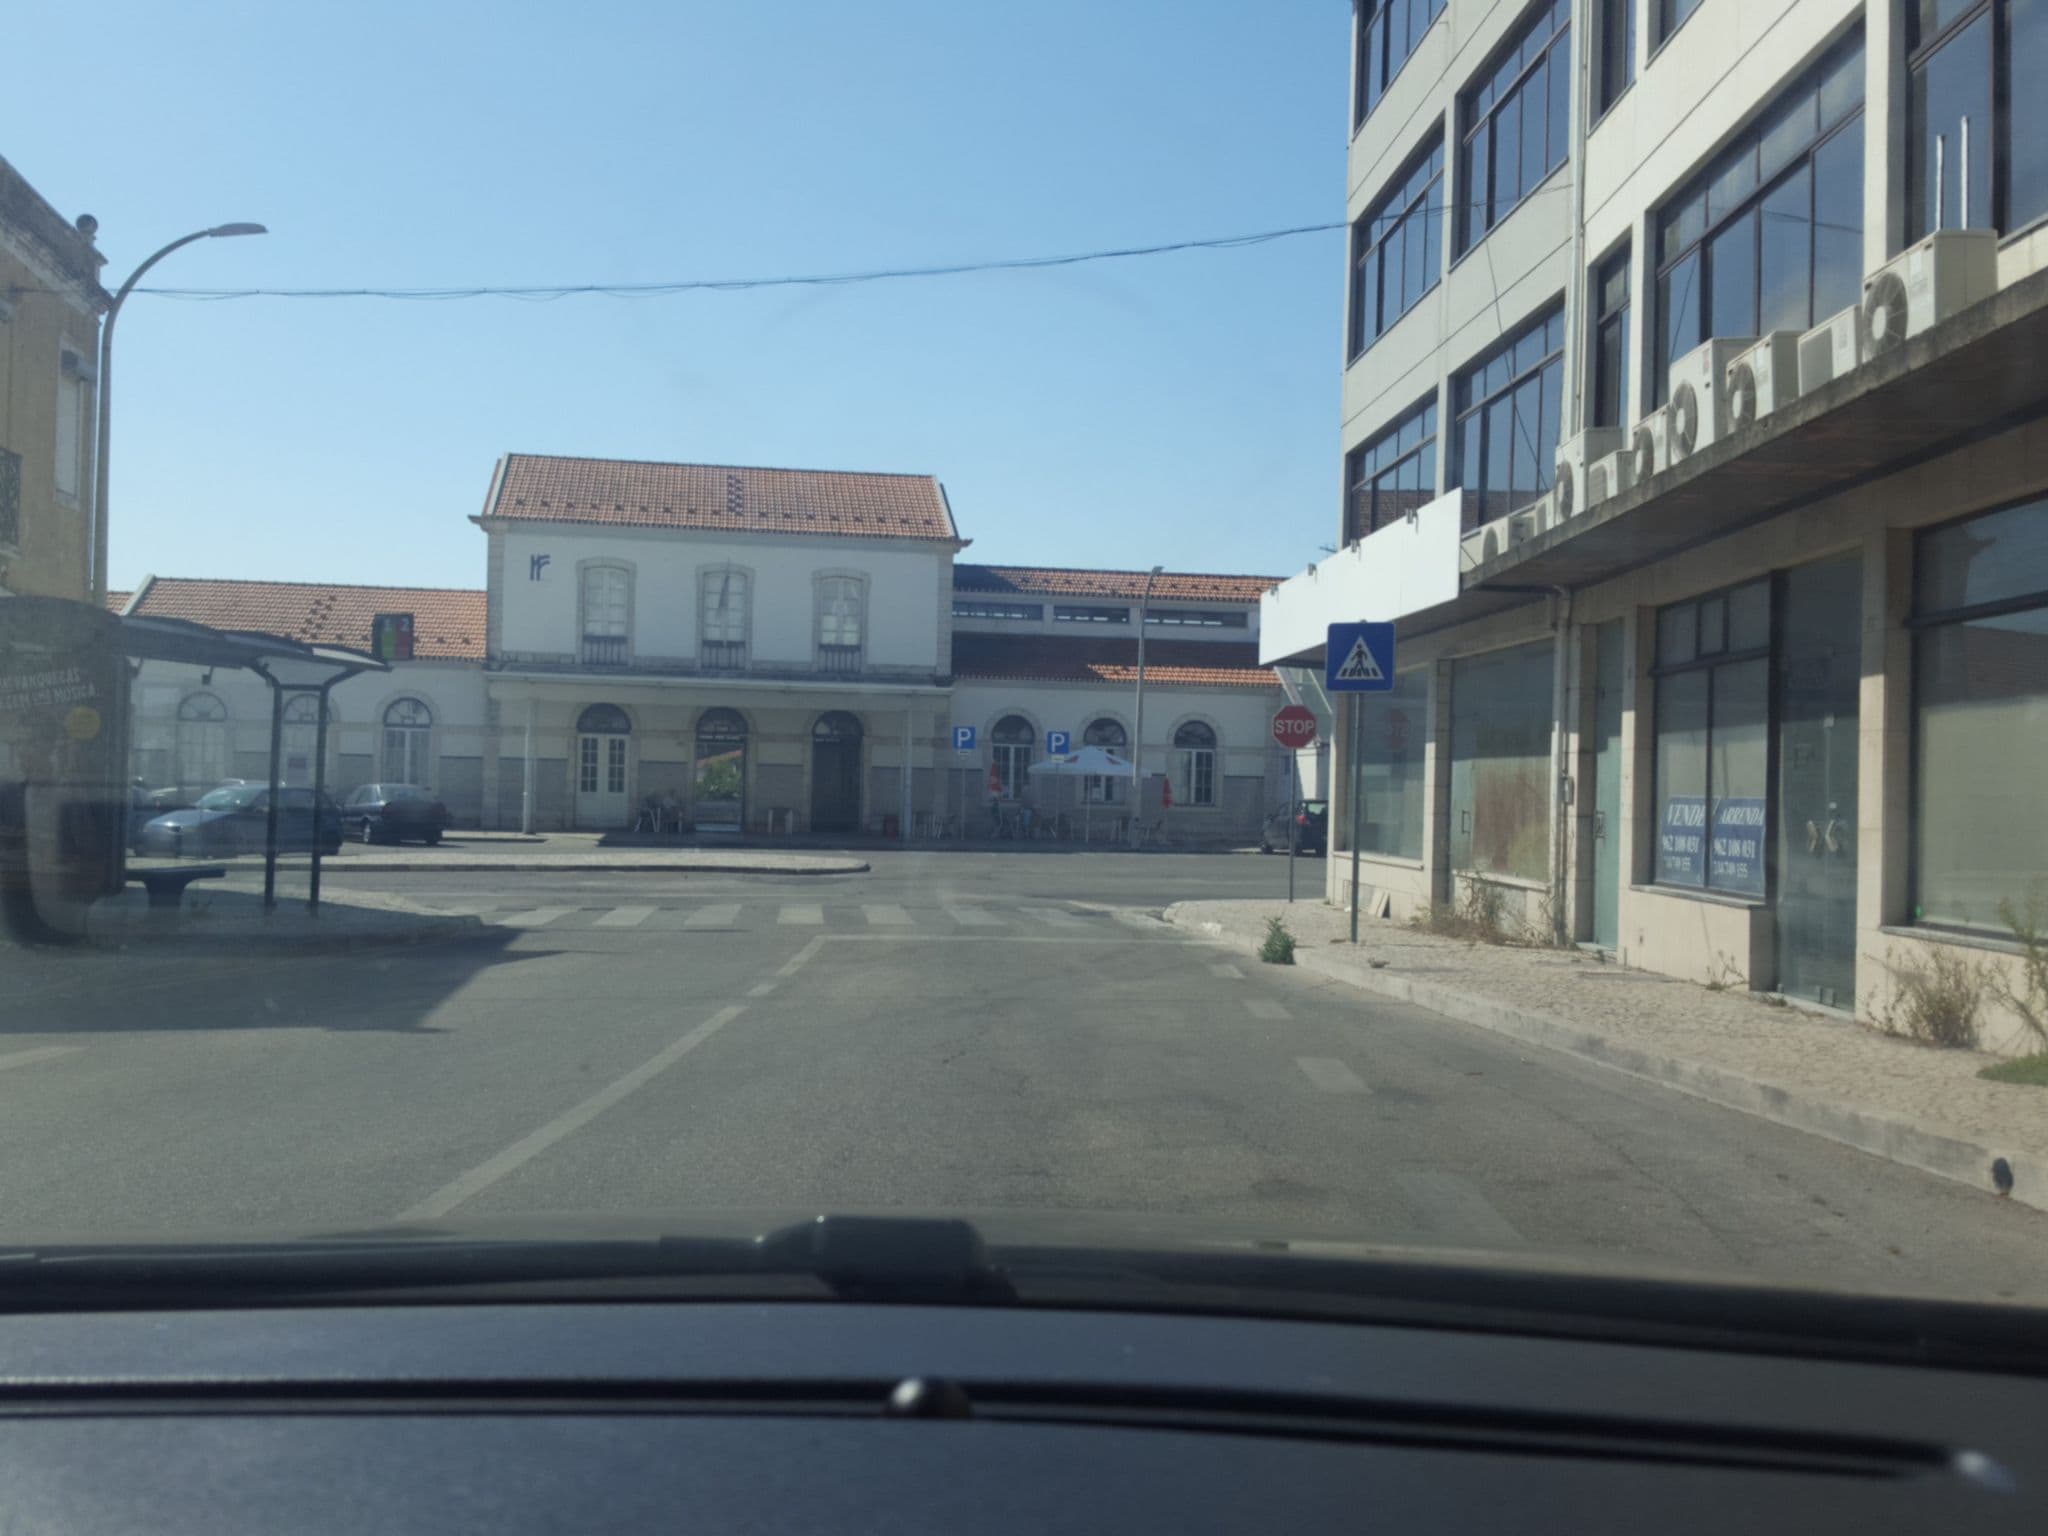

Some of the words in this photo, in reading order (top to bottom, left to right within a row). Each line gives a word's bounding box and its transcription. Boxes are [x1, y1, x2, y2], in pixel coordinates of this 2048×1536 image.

[1274, 719, 1315, 735] STOP
[957, 728, 971, 748] P
[1051, 733, 1065, 753] P
[1667, 804, 1706, 826] VENDE
[1718, 806, 1765, 826] ARRENDA
